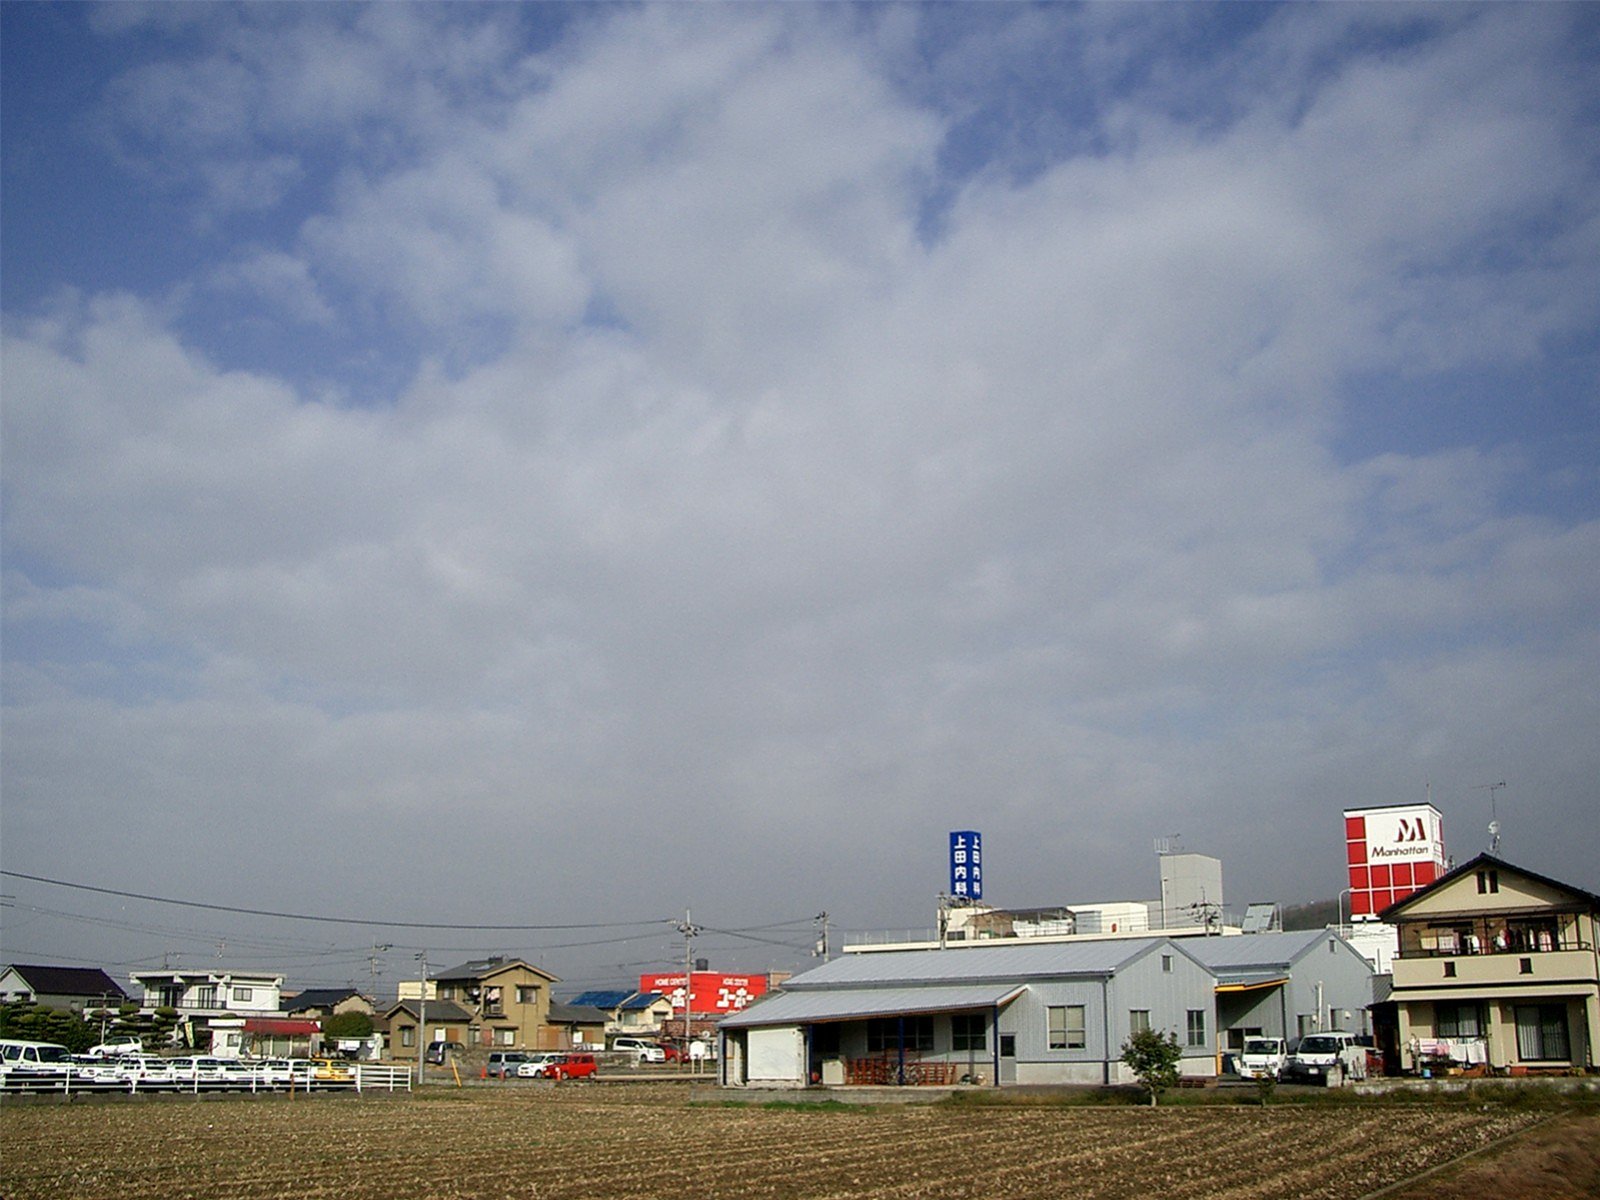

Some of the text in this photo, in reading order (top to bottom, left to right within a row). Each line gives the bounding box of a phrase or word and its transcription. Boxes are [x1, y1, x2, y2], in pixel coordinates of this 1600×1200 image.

[954, 835, 967, 895] 上田内科
[972, 835, 980, 895] 上田内科
[1371, 846, 1429, 858] Manhattan
